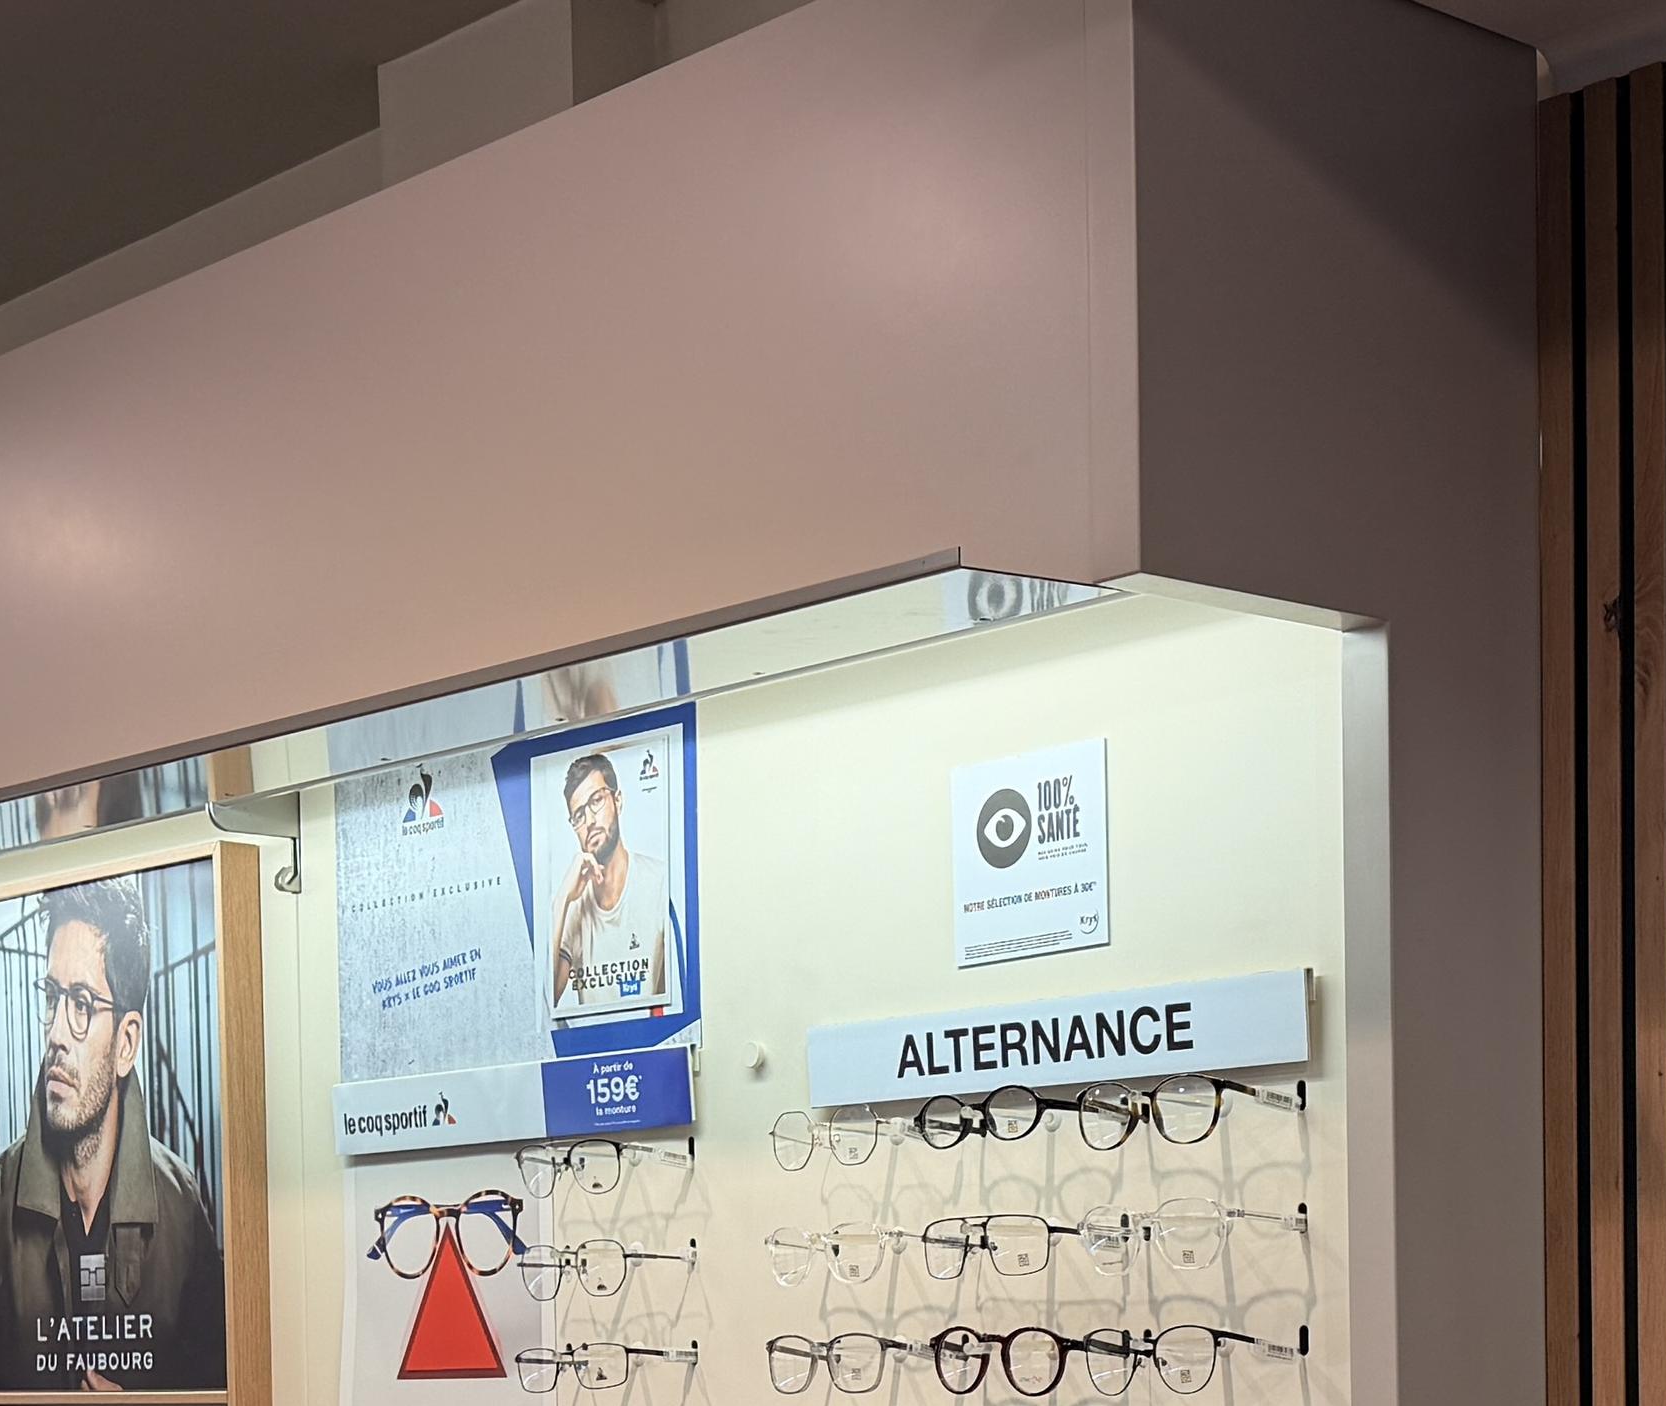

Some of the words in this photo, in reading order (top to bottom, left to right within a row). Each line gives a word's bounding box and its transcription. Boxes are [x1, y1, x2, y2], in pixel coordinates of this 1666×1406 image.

[1037, 774, 1075, 812] 100%
[1037, 804, 1080, 844] SANTÉ
[351, 891, 424, 913] COLLECTION
[433, 876, 502, 897] EXCLUSIVE
[963, 901, 985, 913] NOTRE
[987, 894, 1023, 910] SÉLECTION
[1024, 892, 1033, 902] DE
[1034, 886, 1072, 901] MONTURES
[371, 977, 392, 994] VOUS
[395, 969, 416, 987] ALLEZ
[419, 961, 440, 979] VOUS
[442, 952, 467, 970] AIMER
[470, 948, 482, 962] EN
[412, 986, 421, 1000] LE
[423, 980, 441, 996] COQ
[443, 967, 477, 989] SPORTIF
[569, 958, 649, 979] COLLECTION
[572, 970, 647, 990] EXCLUSIVE
[896, 1001, 1195, 1079] ALTERNANCE
[601, 1063, 621, 1075] partir
[344, 1113, 356, 1135] le
[358, 1114, 383, 1137] coq
[384, 1105, 427, 1135] sportif
[596, 1106, 603, 1116] la
[604, 1105, 637, 1115] monture
[36, 1314, 153, 1342] L'ATELIER
[36, 1354, 57, 1371] DU
[66, 1351, 154, 1371] FAUBOURG
